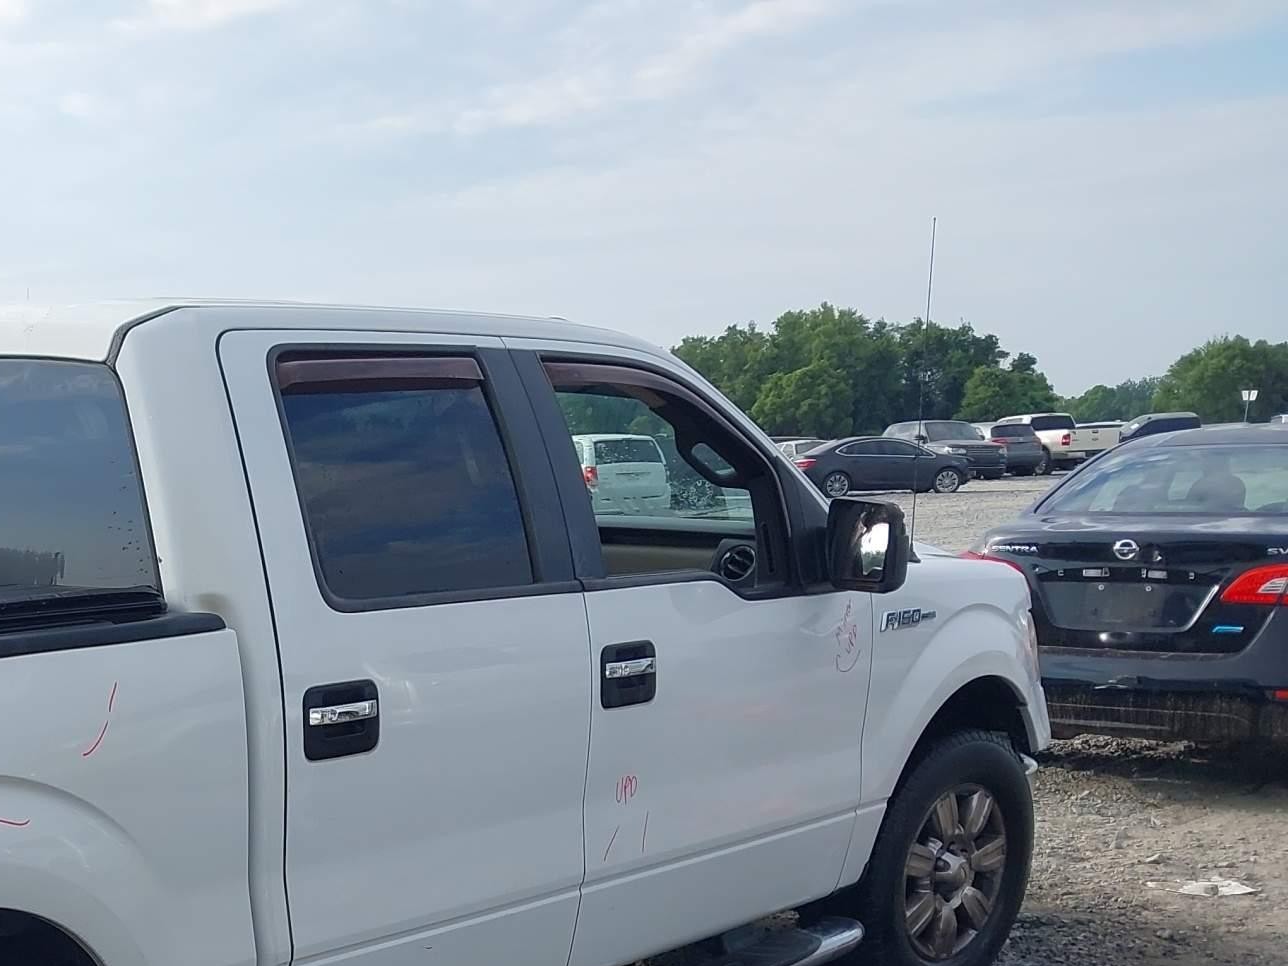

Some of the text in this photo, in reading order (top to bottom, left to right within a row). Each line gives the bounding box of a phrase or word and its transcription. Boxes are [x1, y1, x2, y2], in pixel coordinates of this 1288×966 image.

[991, 545, 1039, 553] SENTRA
[1266, 547, 1288, 555] SV
[615, 775, 638, 805] UPD
